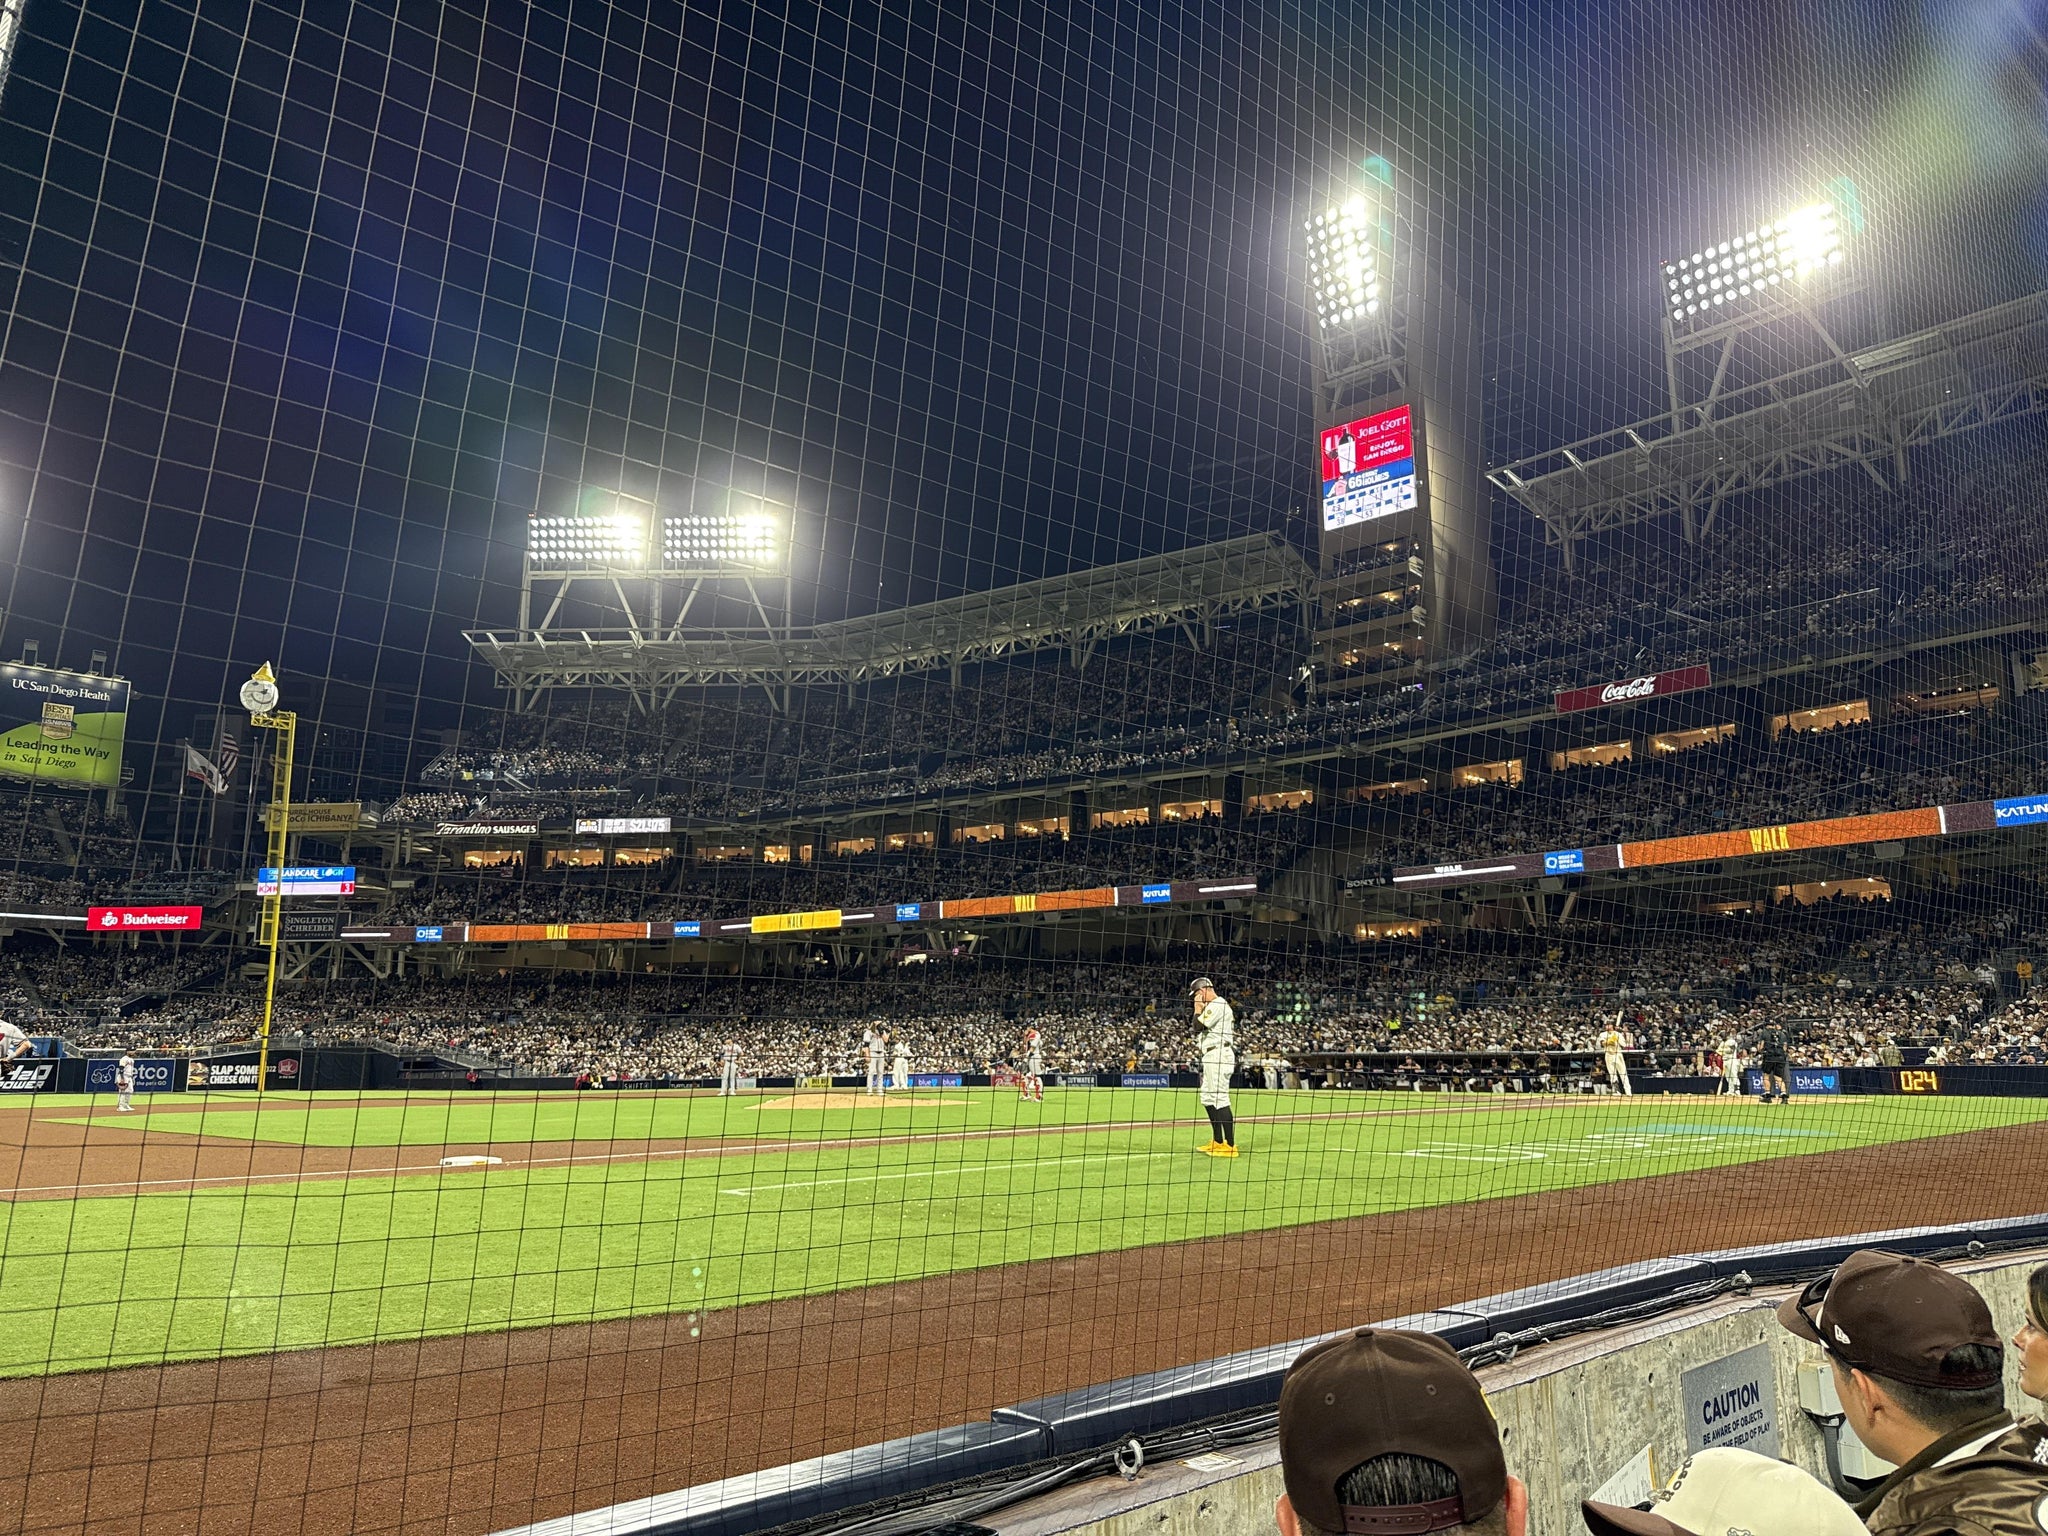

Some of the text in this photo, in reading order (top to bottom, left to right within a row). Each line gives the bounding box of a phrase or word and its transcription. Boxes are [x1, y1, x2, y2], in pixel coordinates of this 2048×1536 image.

[1358, 416, 1408, 438] JOEL GOTT
[1363, 444, 1404, 461] SAN DIEGO
[1348, 475, 1362, 489] 66
[12, 678, 110, 701] UC San Diego Health
[45, 704, 72, 715] BEST
[6, 737, 109, 759] Leading the Way
[4, 752, 76, 769] in San Diego
[307, 813, 353, 823] ICHIBANYA
[435, 822, 537, 835] Tarantino SAUSAGES
[1749, 826, 1790, 853] WALK
[281, 868, 319, 878] LANDCARE
[1434, 864, 1463, 873] WALK
[344, 883, 350, 892] 3
[1346, 879, 1374, 888] SONY
[1142, 889, 1170, 898] KATUN
[1014, 895, 1036, 913] WALK
[122, 912, 189, 926] Budweiser
[285, 916, 335, 924] SINGLETON
[787, 915, 804, 928] WALK
[284, 924, 334, 932] SCHREIBER
[546, 925, 569, 940] WALK
[211, 1065, 260, 1076] SLAP SOME
[210, 1075, 259, 1085] CHEESE ON IT
[1796, 1076, 1823, 1086] blue
[1703, 1380, 1760, 1425] CAUTION
[1703, 1409, 1764, 1445] BE AWARE OF OBJECTS
[1734, 1432, 1750, 1447] FIELD
[1750, 1427, 1757, 1439] OF
[1758, 1421, 1771, 1436] PLAY
